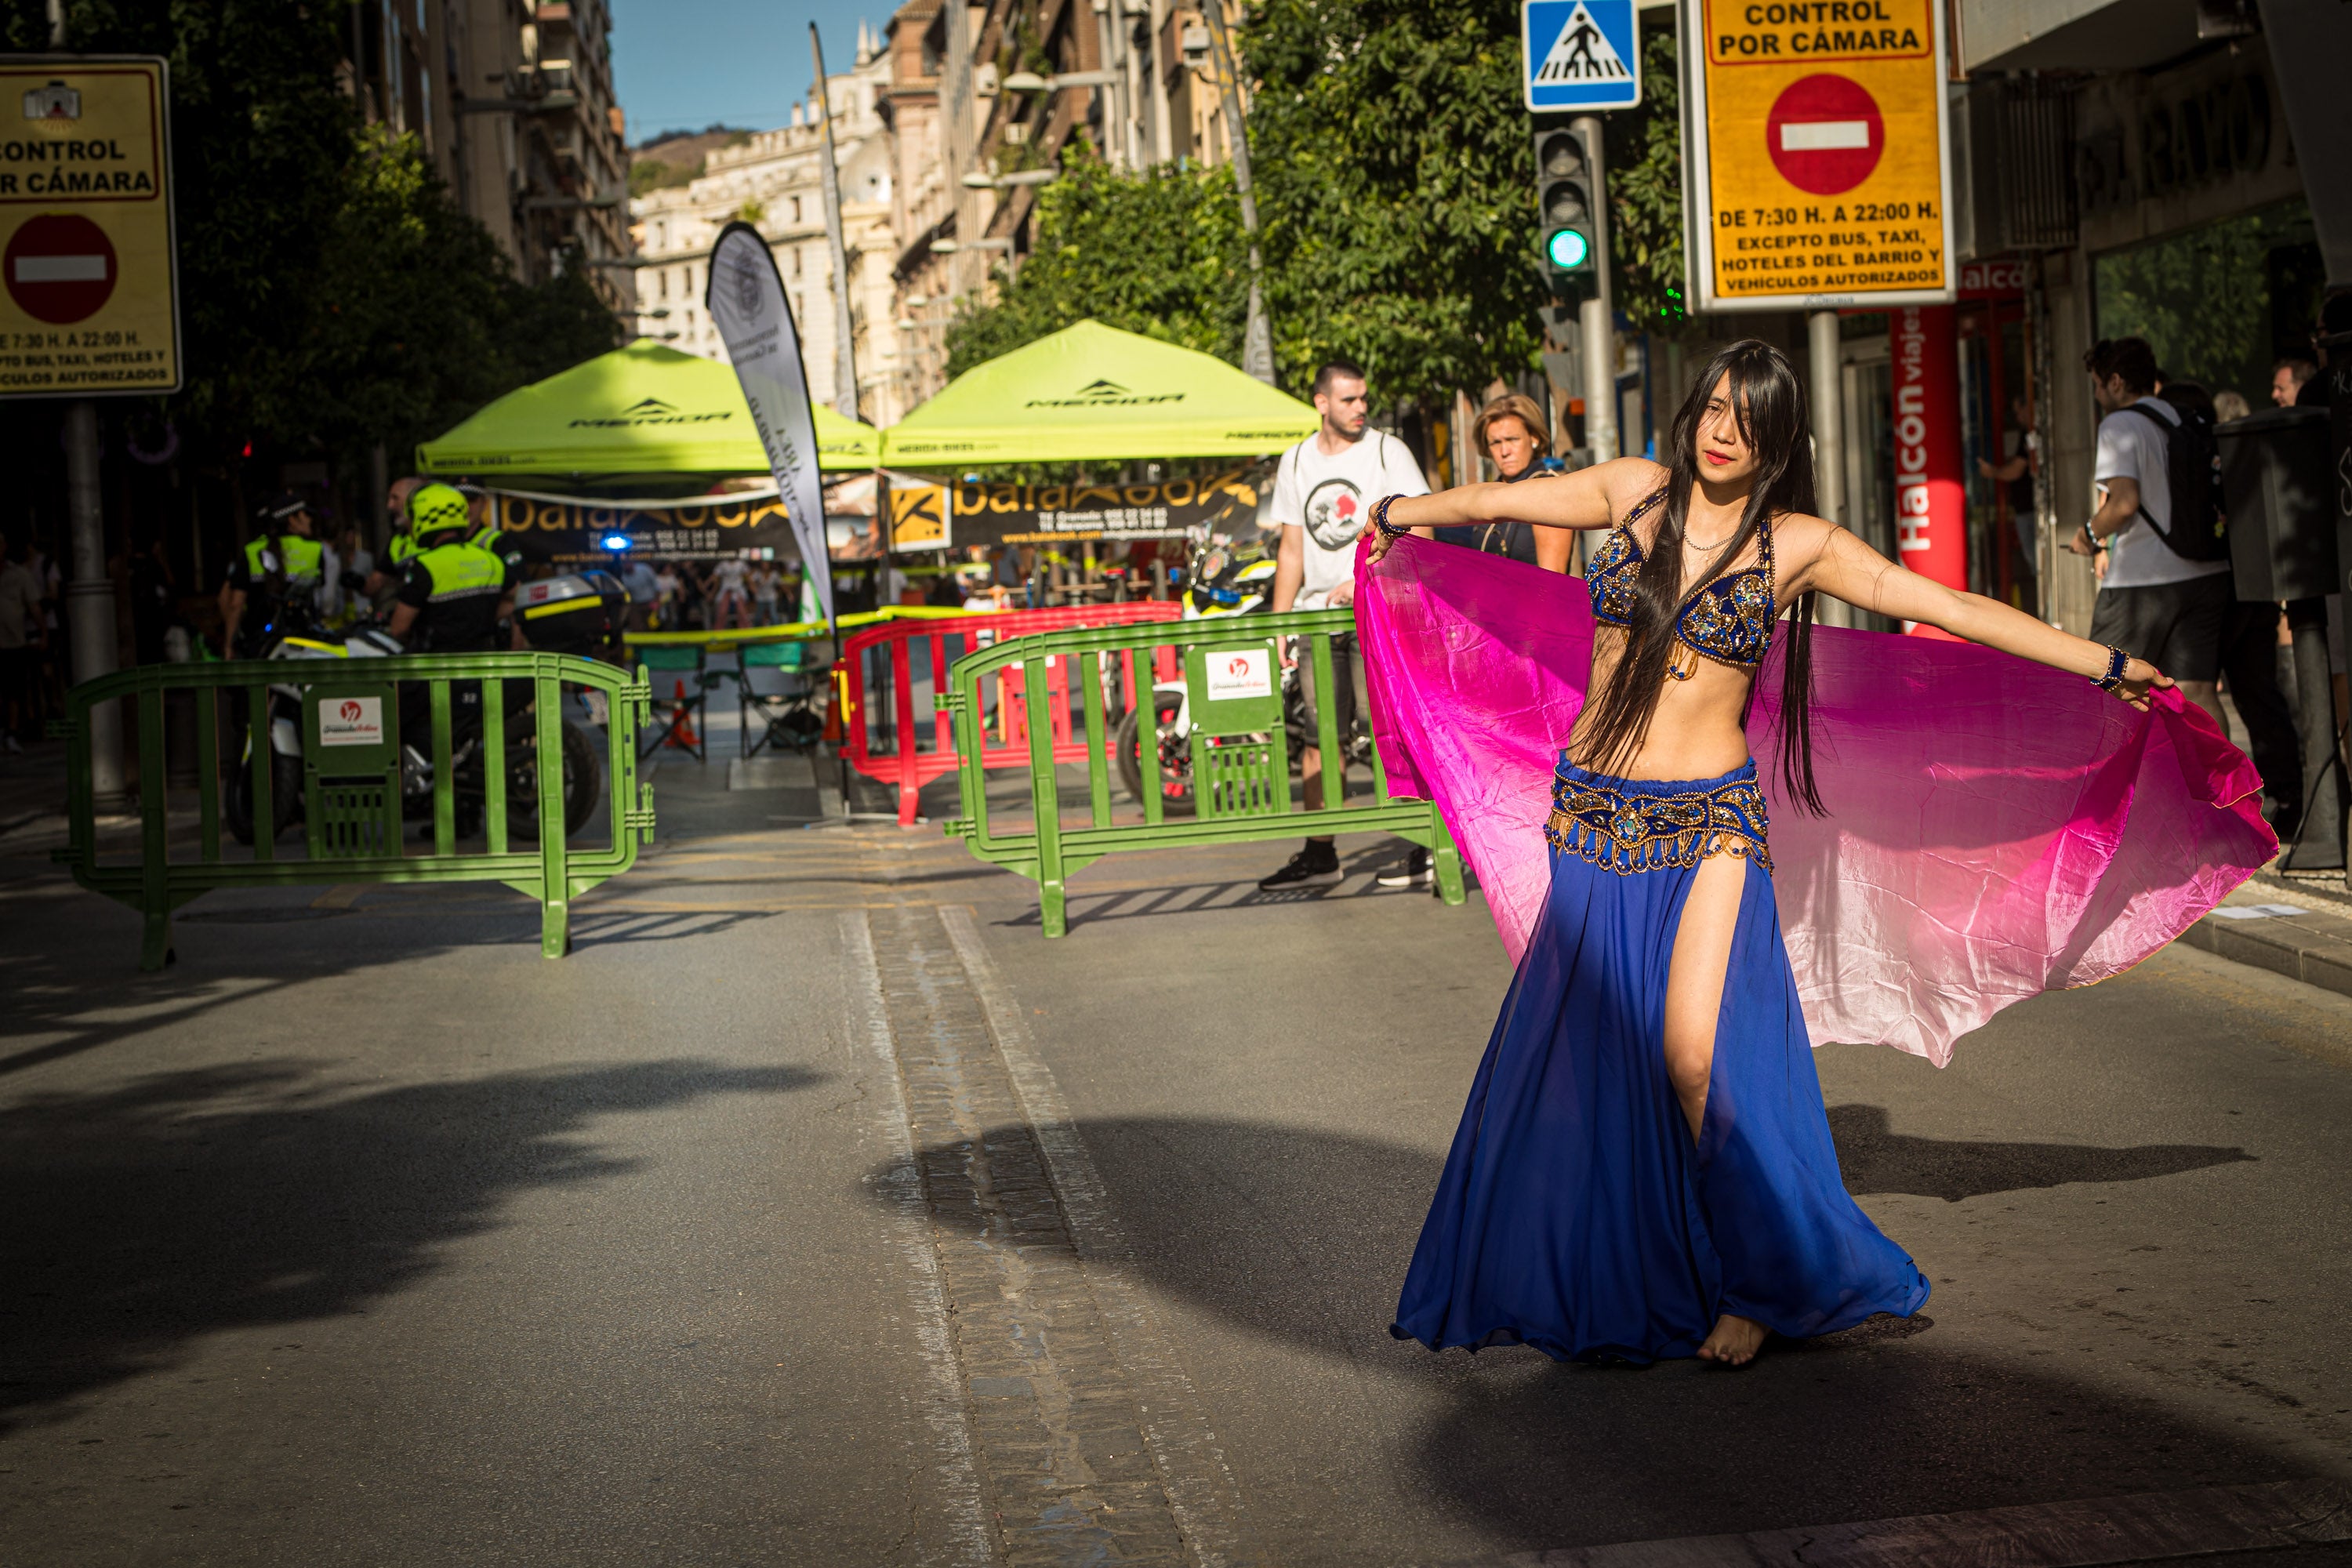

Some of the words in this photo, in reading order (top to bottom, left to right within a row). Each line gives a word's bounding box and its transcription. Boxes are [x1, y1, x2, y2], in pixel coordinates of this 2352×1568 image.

[1745, 1, 1890, 25] CONTROL
[1719, 34, 1780, 56] POR
[1791, 27, 1920, 53] CÁMARA
[0, 140, 125, 161] ONTROL
[1, 174, 17, 193] R
[27, 165, 151, 192] CÁMARA
[1720, 210, 1746, 227] DE
[1754, 208, 1797, 226] 7:30
[1806, 207, 1826, 223] H.
[1834, 206, 1847, 222] A
[1854, 203, 1910, 221] 22:00
[1918, 202, 1938, 220] H.
[1737, 234, 1823, 251] EXCEPTO
[1829, 232, 1873, 247] BUS,
[1878, 229, 1926, 245] TAXI,
[1722, 255, 1806, 272] HOTELES
[1813, 252, 1847, 267] DEL
[1853, 250, 1923, 265] BARRIO
[1929, 249, 1940, 261] Y
[1726, 274, 1820, 291] VEHÍCULOS
[1824, 270, 1939, 285] AUTORIZADOS
[67, 332, 78, 346] A
[82, 330, 121, 347] 22:00
[93, 352, 151, 363] HOTELES
[156, 351, 165, 361] Y
[1, 373, 53, 385] CULOS
[58, 369, 167, 383] AUTORIZADOS
[1025, 392, 1187, 408] MERIDA
[568, 411, 733, 429] MERIDA
[1895, 385, 1930, 551] Halcón
[655, 529, 674, 539] 958
